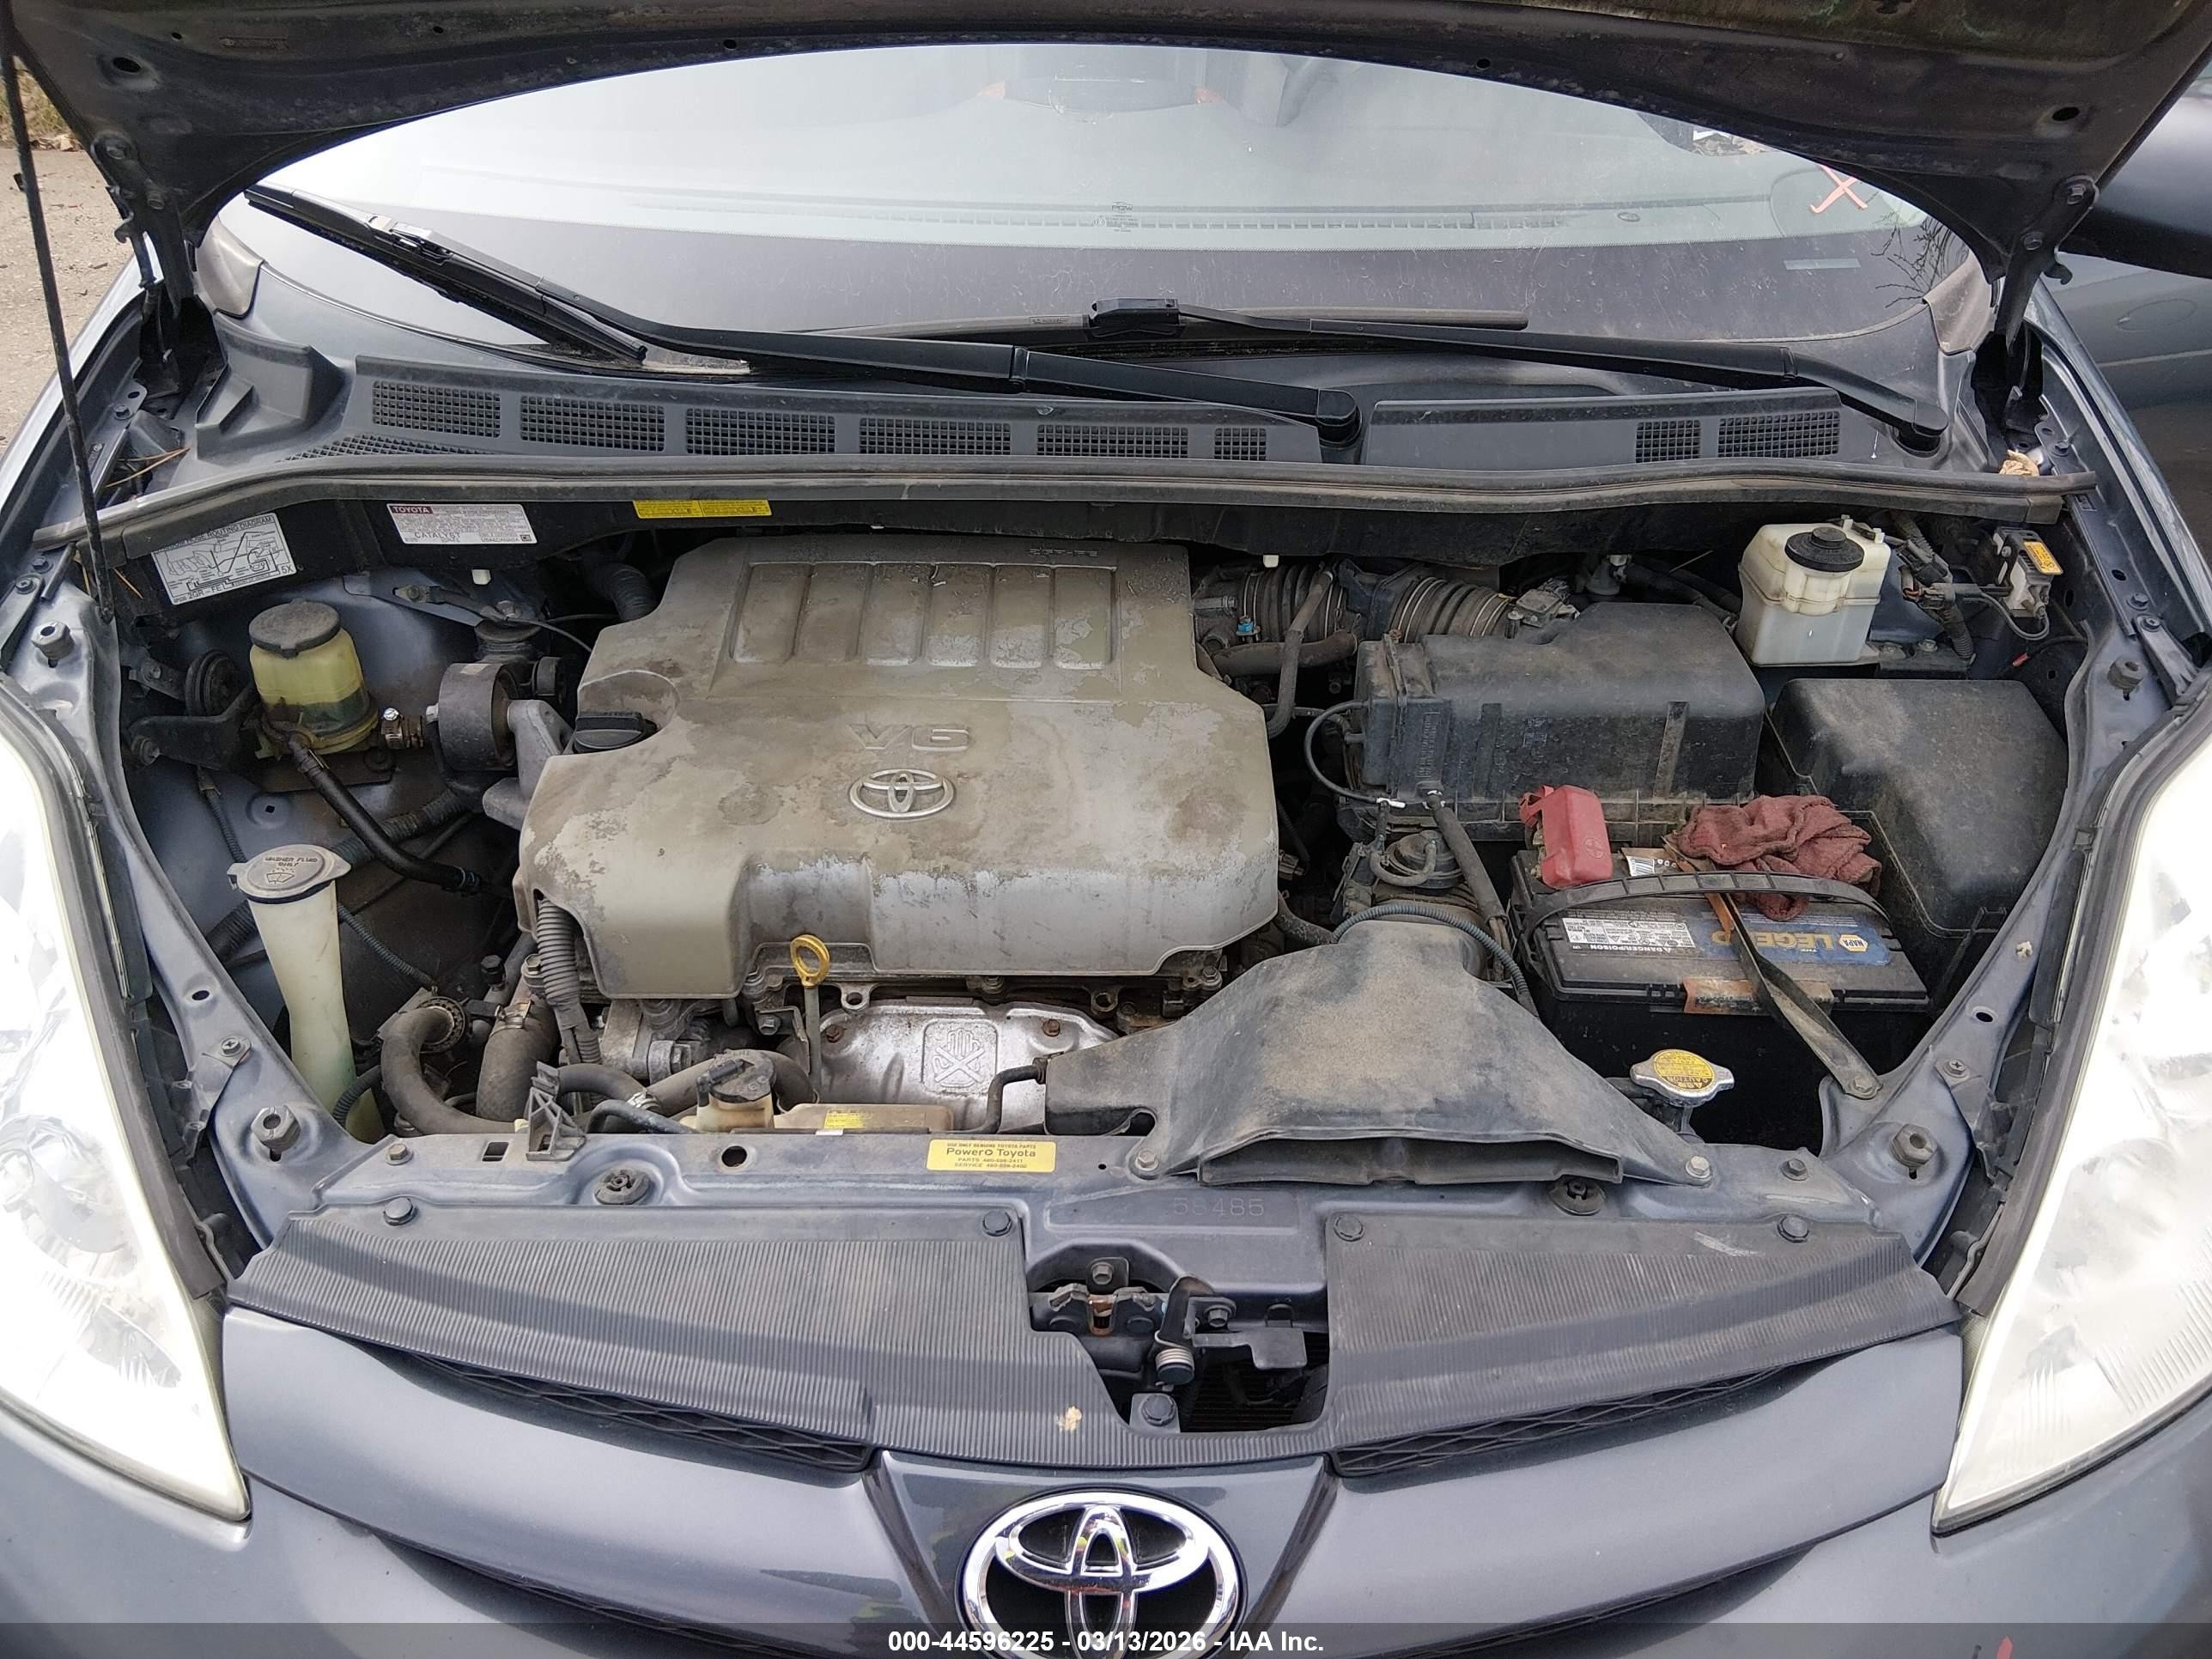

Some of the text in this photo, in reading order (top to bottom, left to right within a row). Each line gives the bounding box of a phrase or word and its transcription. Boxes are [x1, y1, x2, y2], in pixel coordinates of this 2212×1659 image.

[207, 524, 240, 538] ROUTING
[240, 516, 272, 530] DIAGRAM
[281, 565, 294, 574] 5X
[848, 724, 970, 751] V6
[1843, 939, 1864, 947] NAPA
[996, 1148, 1036, 1158] Toyota
